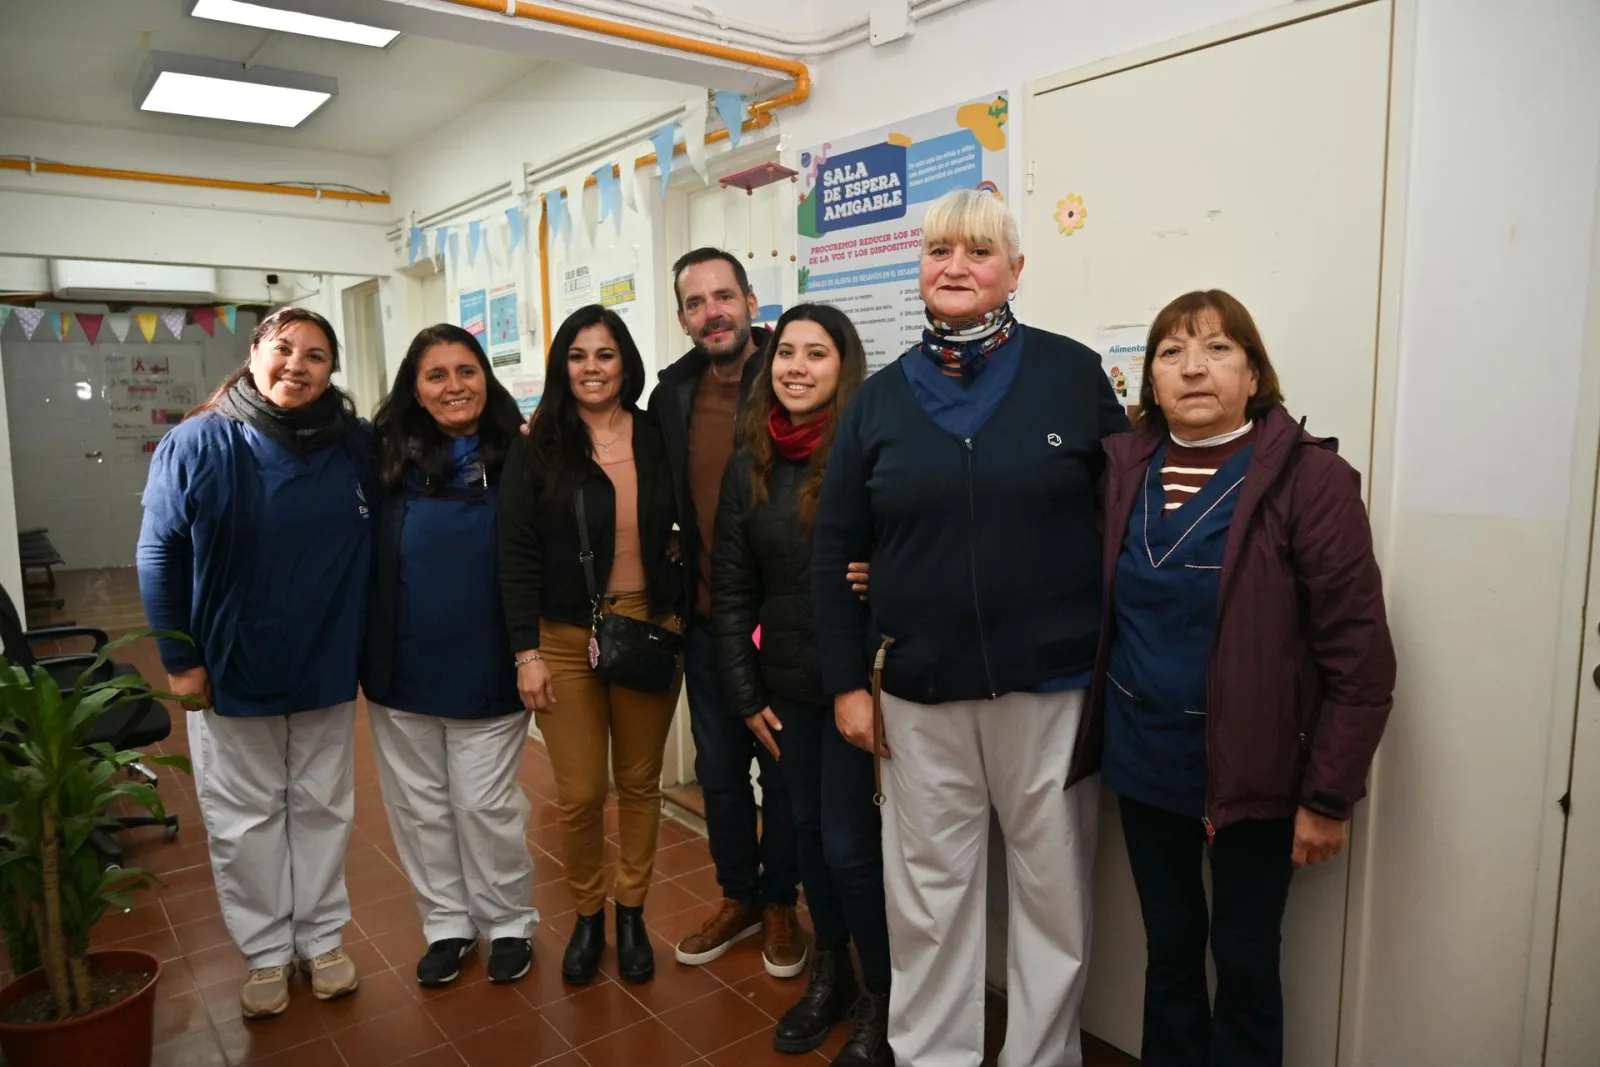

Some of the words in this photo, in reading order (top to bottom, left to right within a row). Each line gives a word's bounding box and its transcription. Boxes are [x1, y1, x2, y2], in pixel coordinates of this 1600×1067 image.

[823, 161, 868, 186] SALA
[824, 186, 841, 204] DE
[845, 172, 900, 199] ESPERA
[824, 190, 902, 221] AMIGABLE
[810, 239, 857, 254] PROCUREMOS
[859, 234, 892, 246] REDUCIR
[894, 230, 908, 240] LOS
[809, 257, 818, 265] DE
[820, 255, 830, 263] LA
[832, 252, 846, 261] VOZ
[854, 248, 868, 258] LOS
[1109, 345, 1147, 354] Alimento
